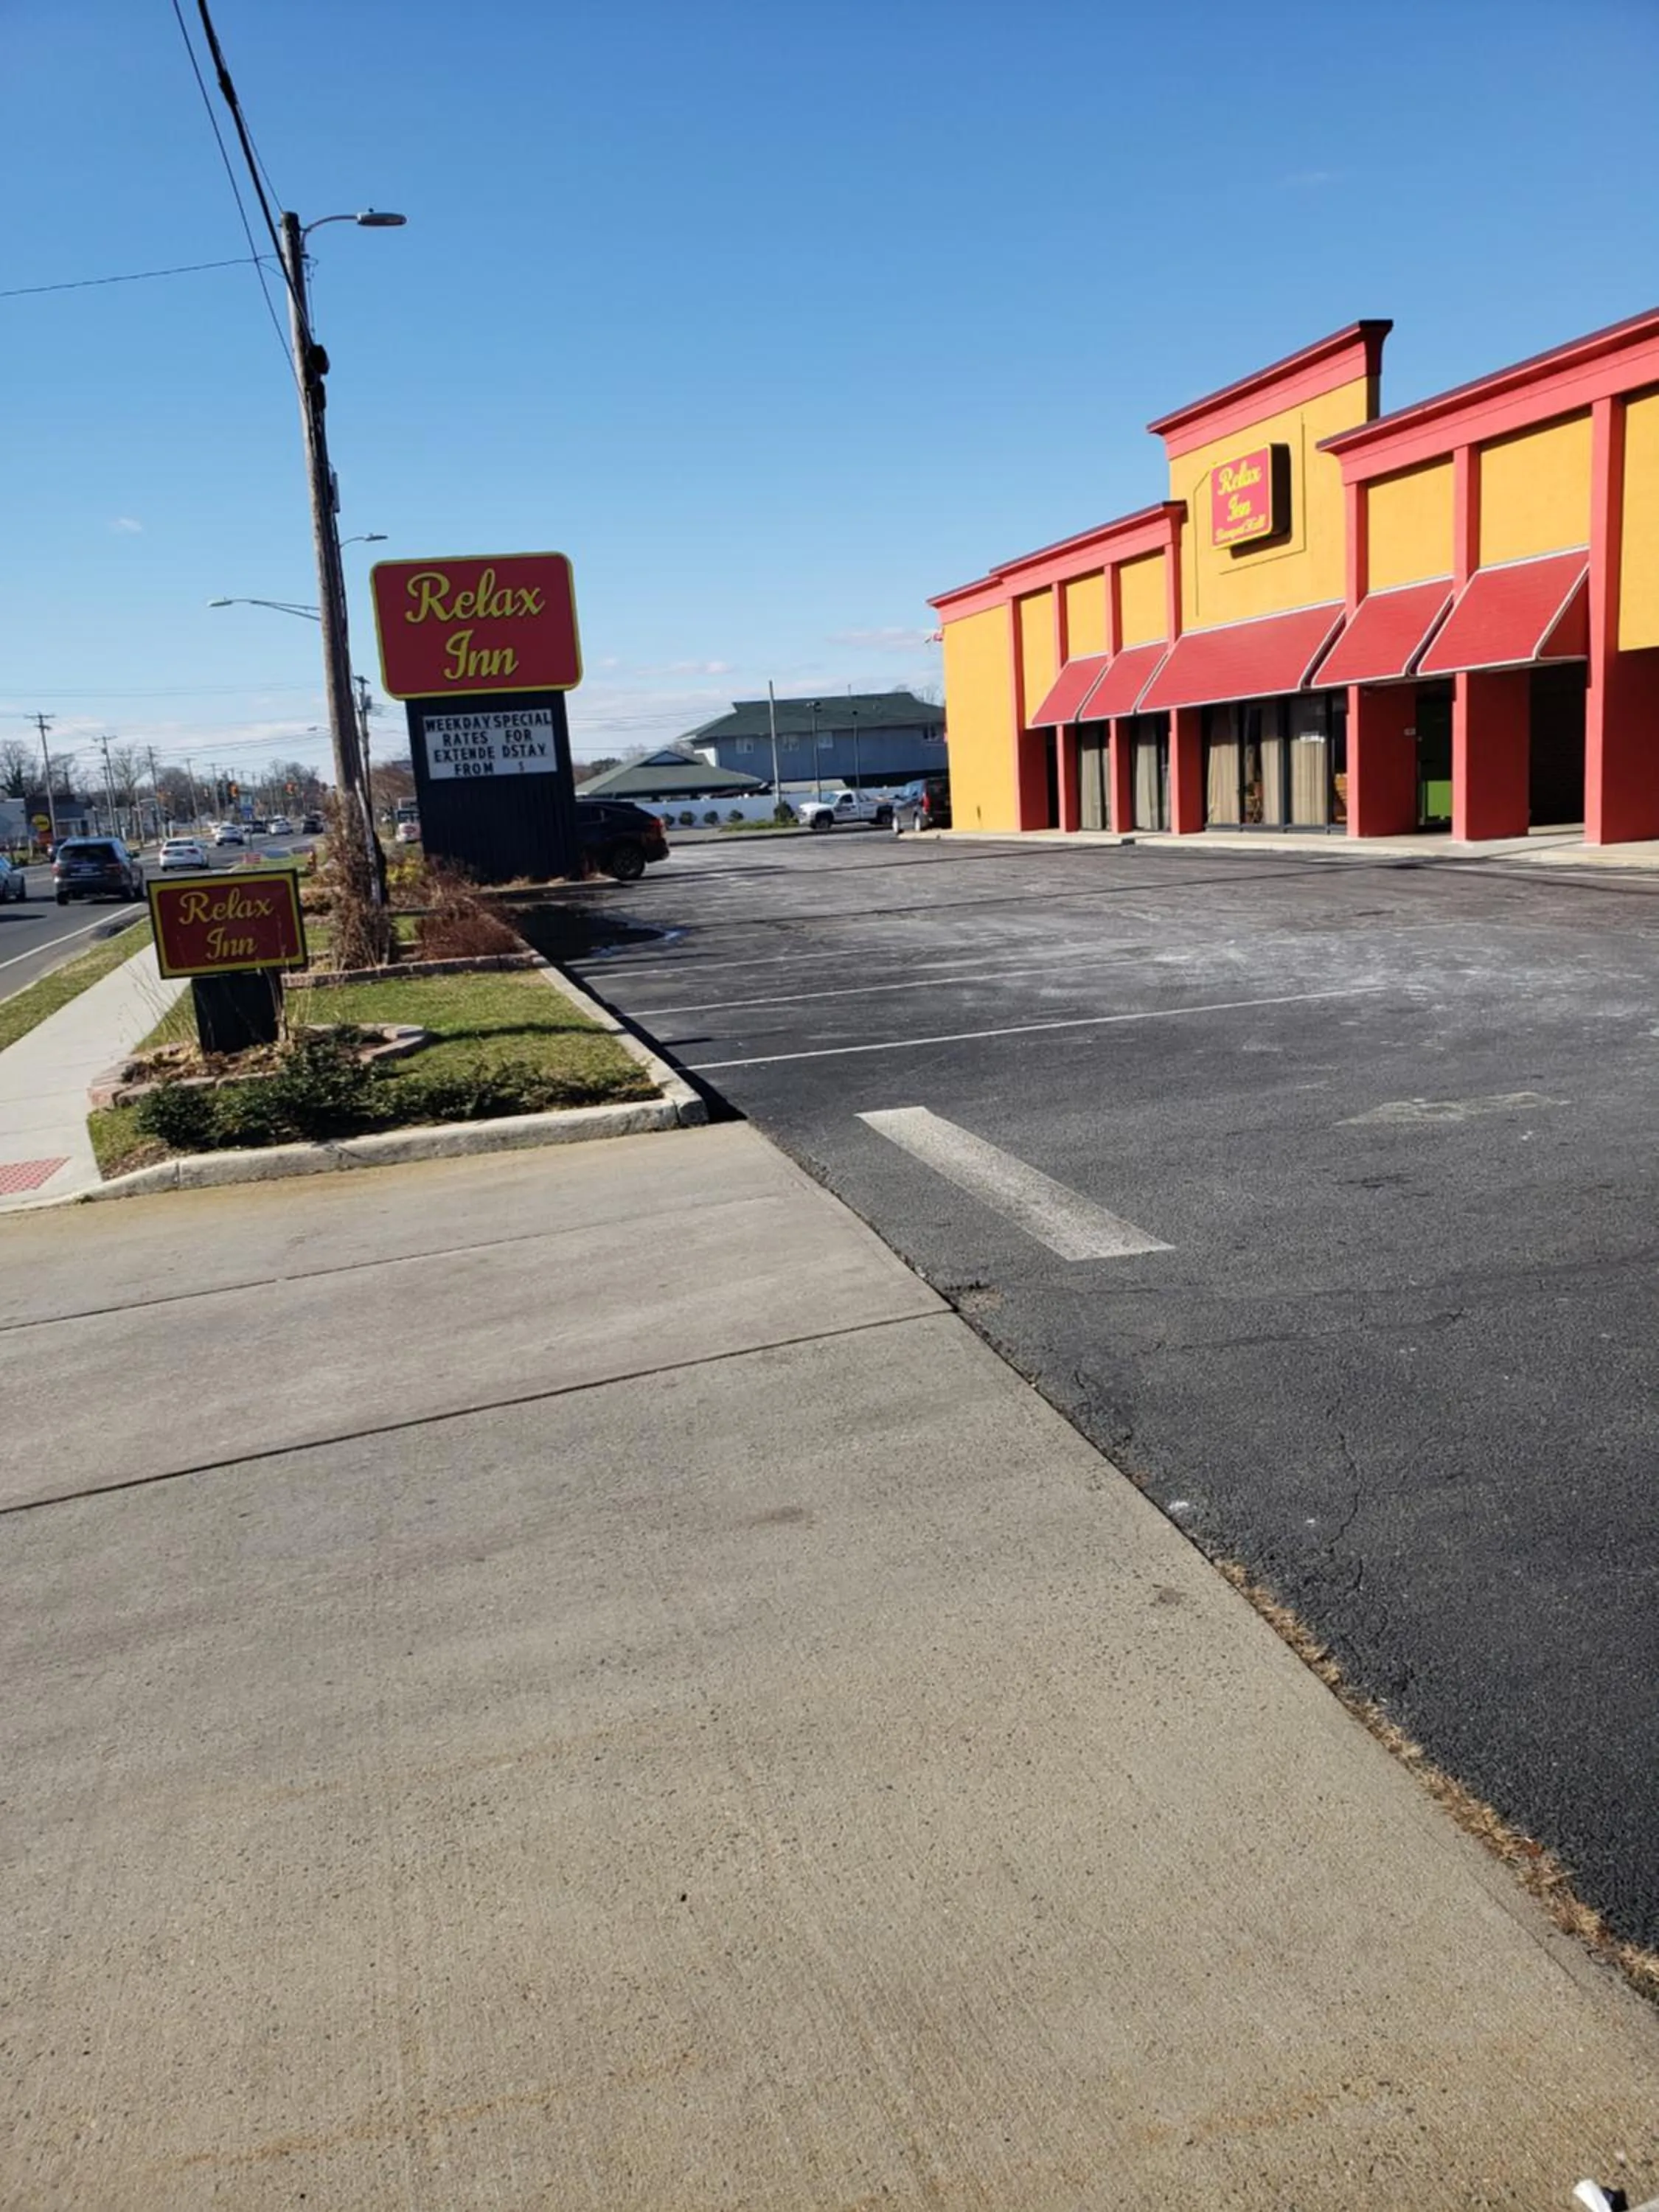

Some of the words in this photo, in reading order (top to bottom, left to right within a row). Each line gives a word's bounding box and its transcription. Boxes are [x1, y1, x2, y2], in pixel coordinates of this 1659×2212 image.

[1218, 461, 1261, 495] Relax
[406, 568, 544, 622] Relax
[445, 630, 518, 679] Inn
[425, 715, 491, 731] WEEKDAY
[493, 712, 552, 728] SPECIAL
[443, 731, 489, 747] RATES
[505, 729, 533, 743] FOR
[454, 762, 494, 776] FROM
[179, 888, 274, 924] Relax
[205, 927, 257, 959] Inn
